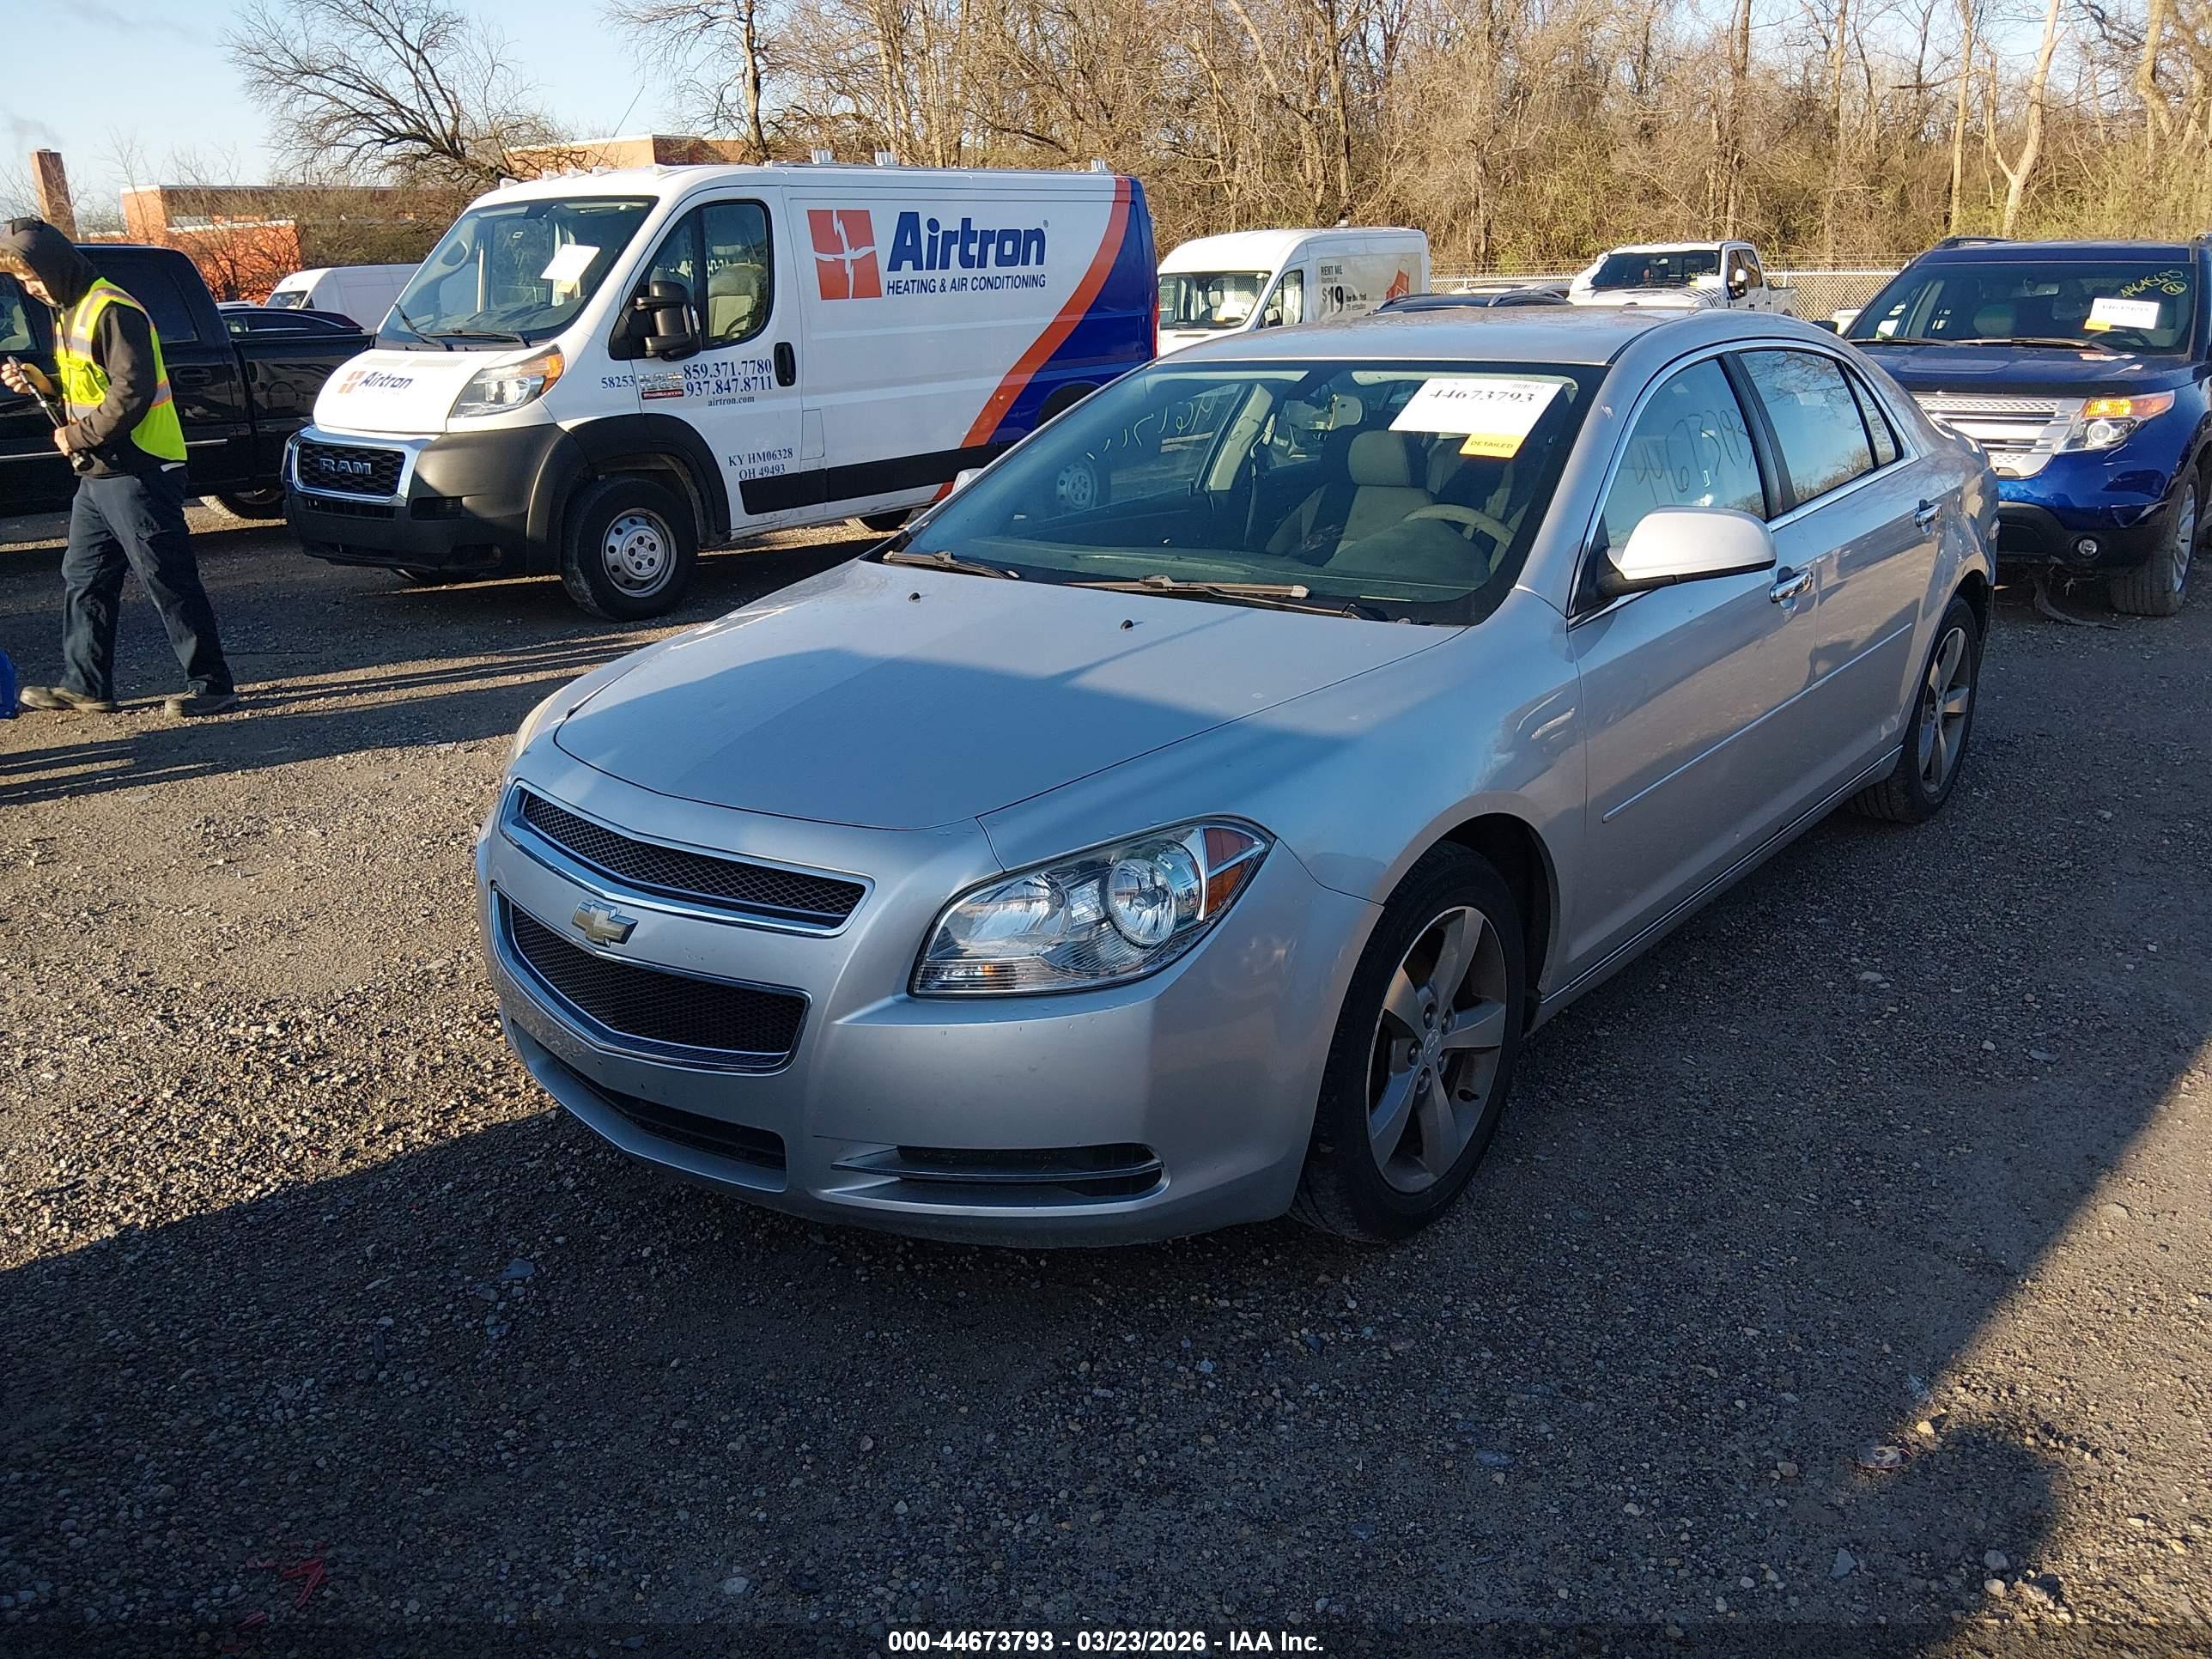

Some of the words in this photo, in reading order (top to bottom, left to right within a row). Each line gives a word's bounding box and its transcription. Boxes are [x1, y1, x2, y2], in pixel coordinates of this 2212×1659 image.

[887, 211, 1046, 272] Airtron
[887, 276, 937, 295] HEATING
[939, 278, 946, 293] &
[950, 276, 968, 293] AIR
[970, 273, 1046, 291] CONDITIONING
[683, 359, 772, 380] 859.371.7780
[358, 371, 414, 390] Airtron
[601, 374, 635, 389] 58253
[686, 375, 773, 398] 937.847.8711
[708, 395, 755, 407] airtron.com
[1429, 389, 1535, 403] 44673793
[1470, 441, 1514, 449] DETAILED
[728, 454, 744, 466] KY
[748, 447, 793, 465] HM06328
[319, 458, 372, 475] RAM
[739, 468, 756, 481] OH
[758, 464, 786, 477] 49493
